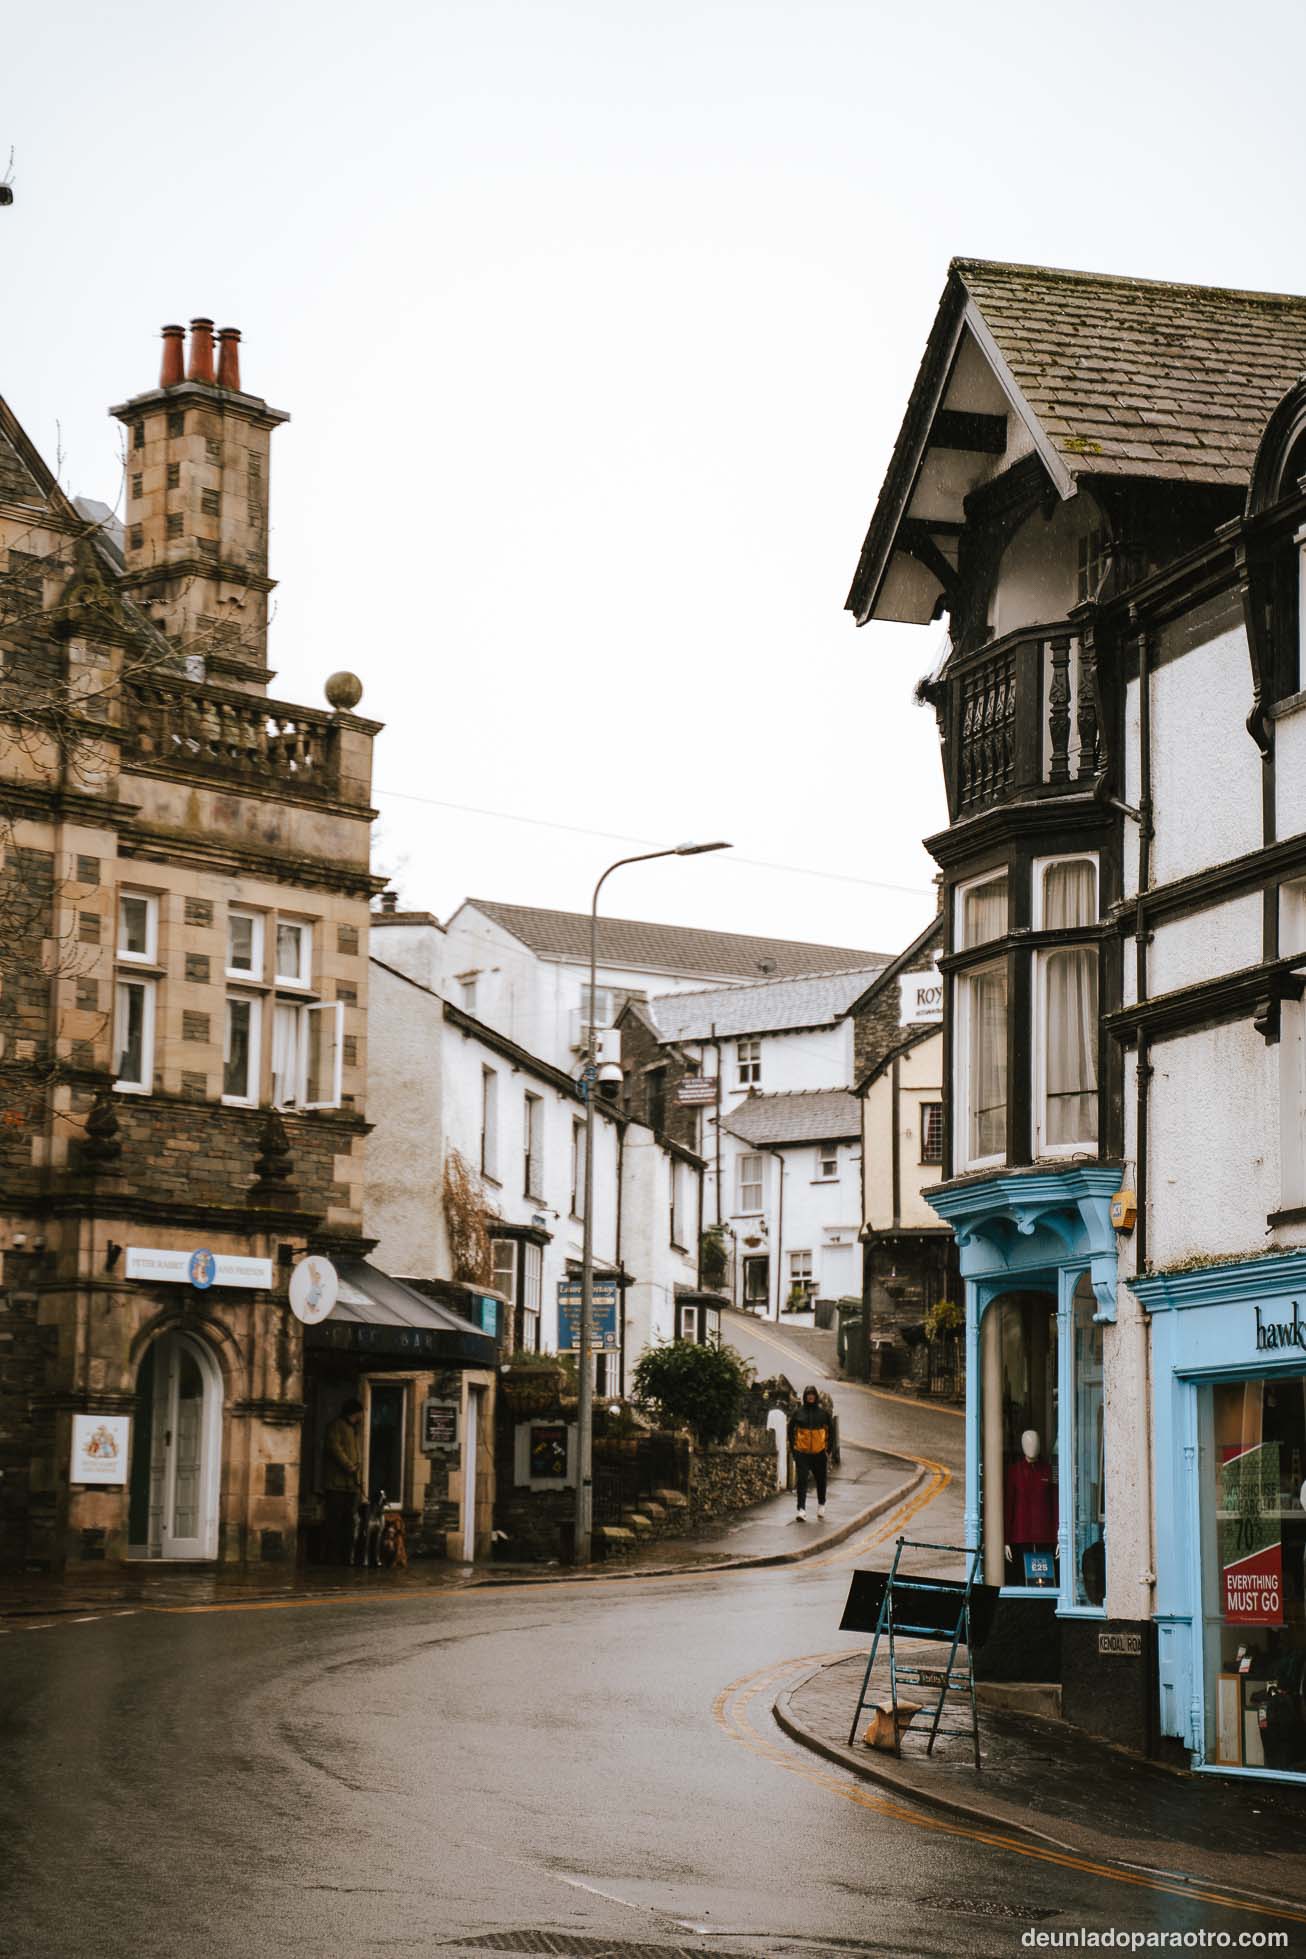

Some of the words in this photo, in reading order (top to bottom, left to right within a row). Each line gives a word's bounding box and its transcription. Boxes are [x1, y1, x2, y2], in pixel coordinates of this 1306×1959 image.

[1227, 1575, 1279, 1590] EVERYTHING
[1227, 1592, 1259, 1612] MUST
[1261, 1592, 1280, 1612] GO
[1099, 1636, 1125, 1651] KENDAL
